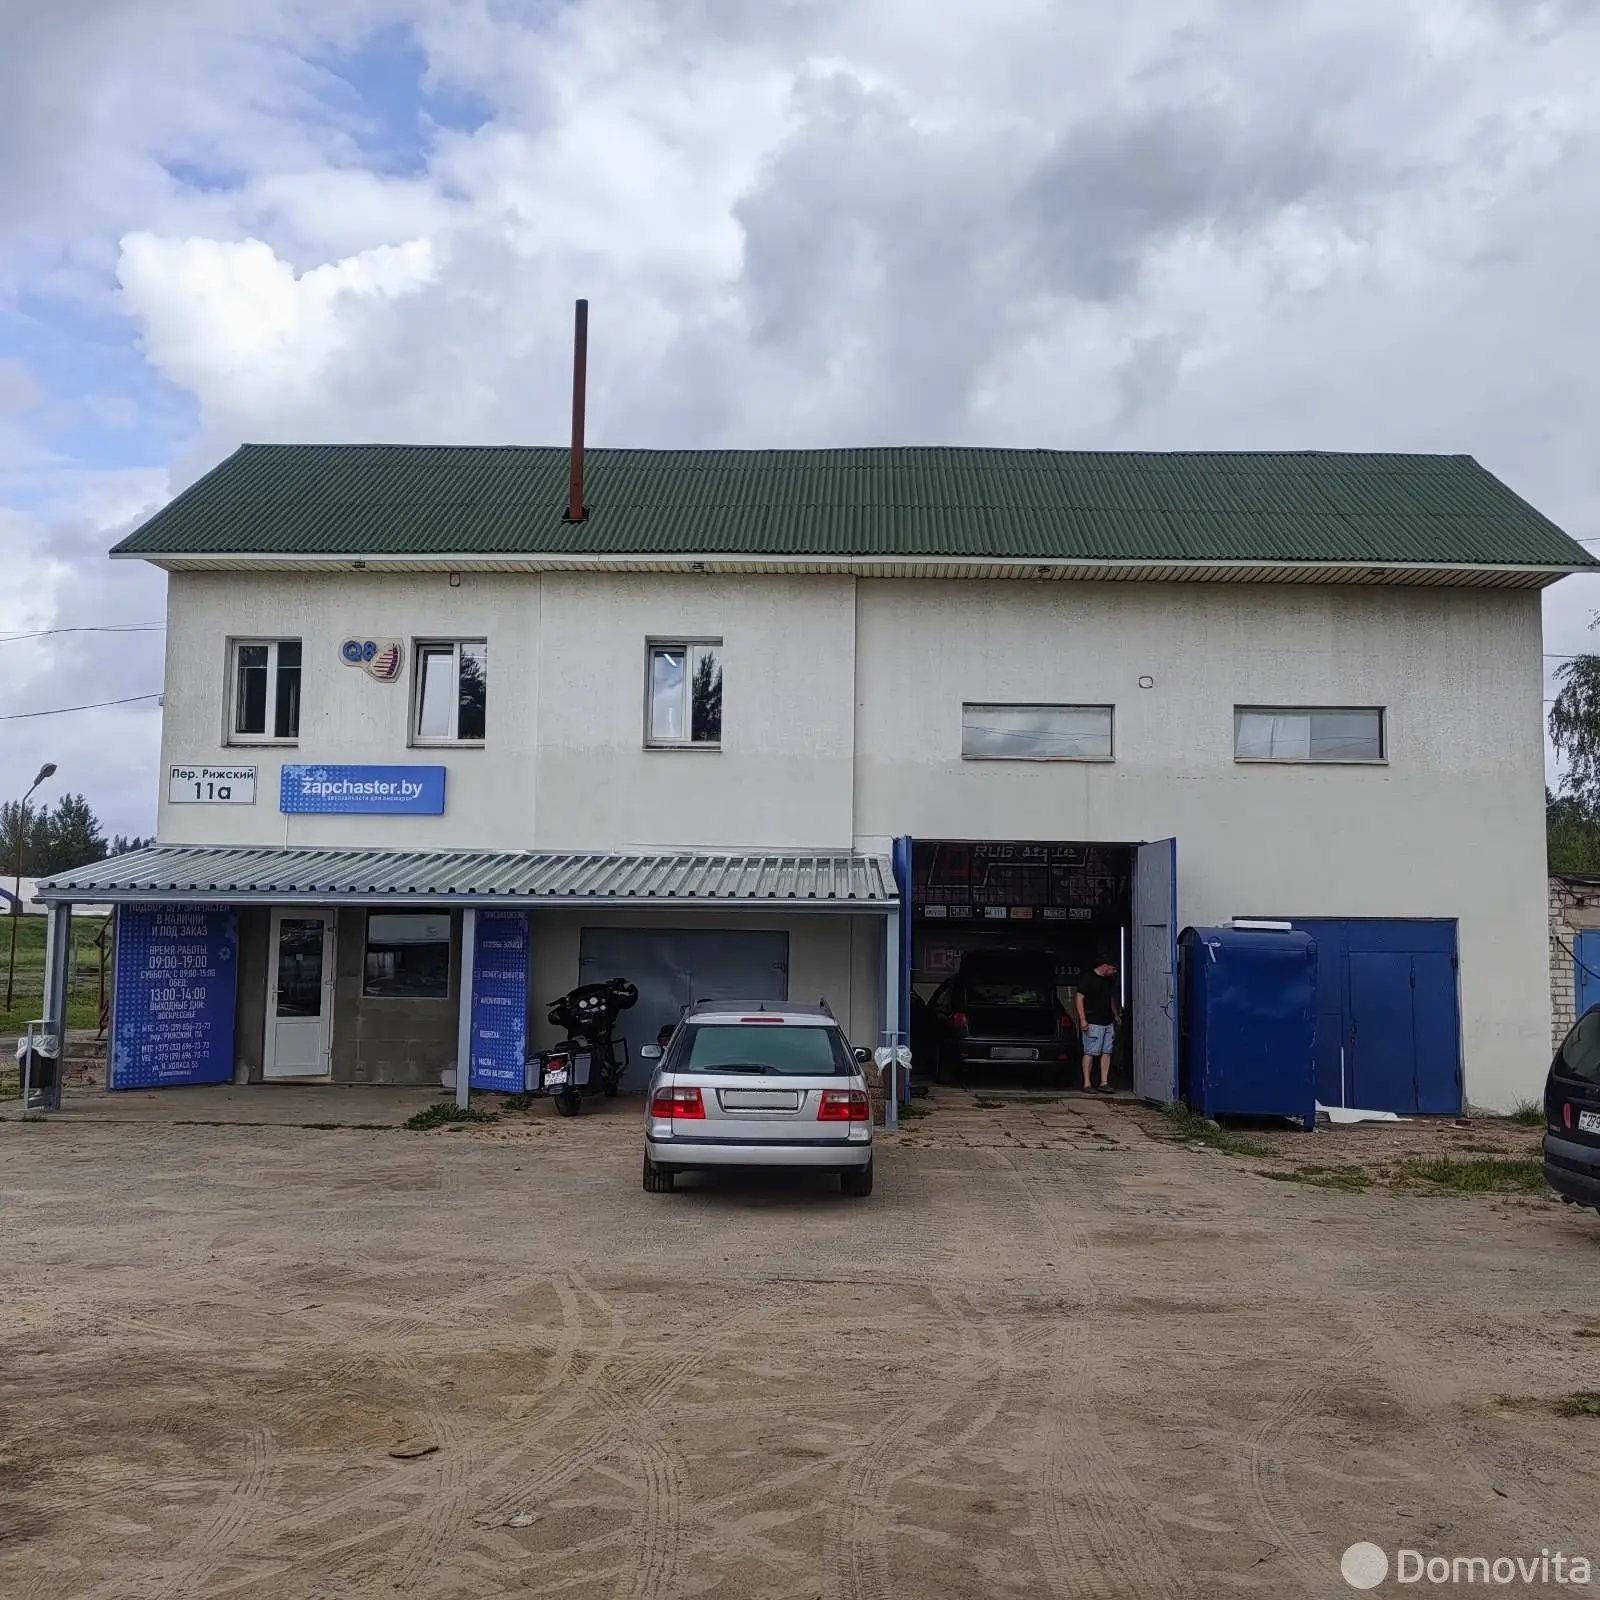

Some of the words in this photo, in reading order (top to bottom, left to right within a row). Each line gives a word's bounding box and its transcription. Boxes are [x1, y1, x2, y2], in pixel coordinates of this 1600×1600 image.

[343, 640, 377, 662] Q8
[172, 768, 198, 780] Пер.
[202, 768, 254, 779] Рижский
[194, 782, 231, 799] 11а
[160, 926, 178, 938] ПОД
[180, 925, 208, 937] ЗАКАЗ
